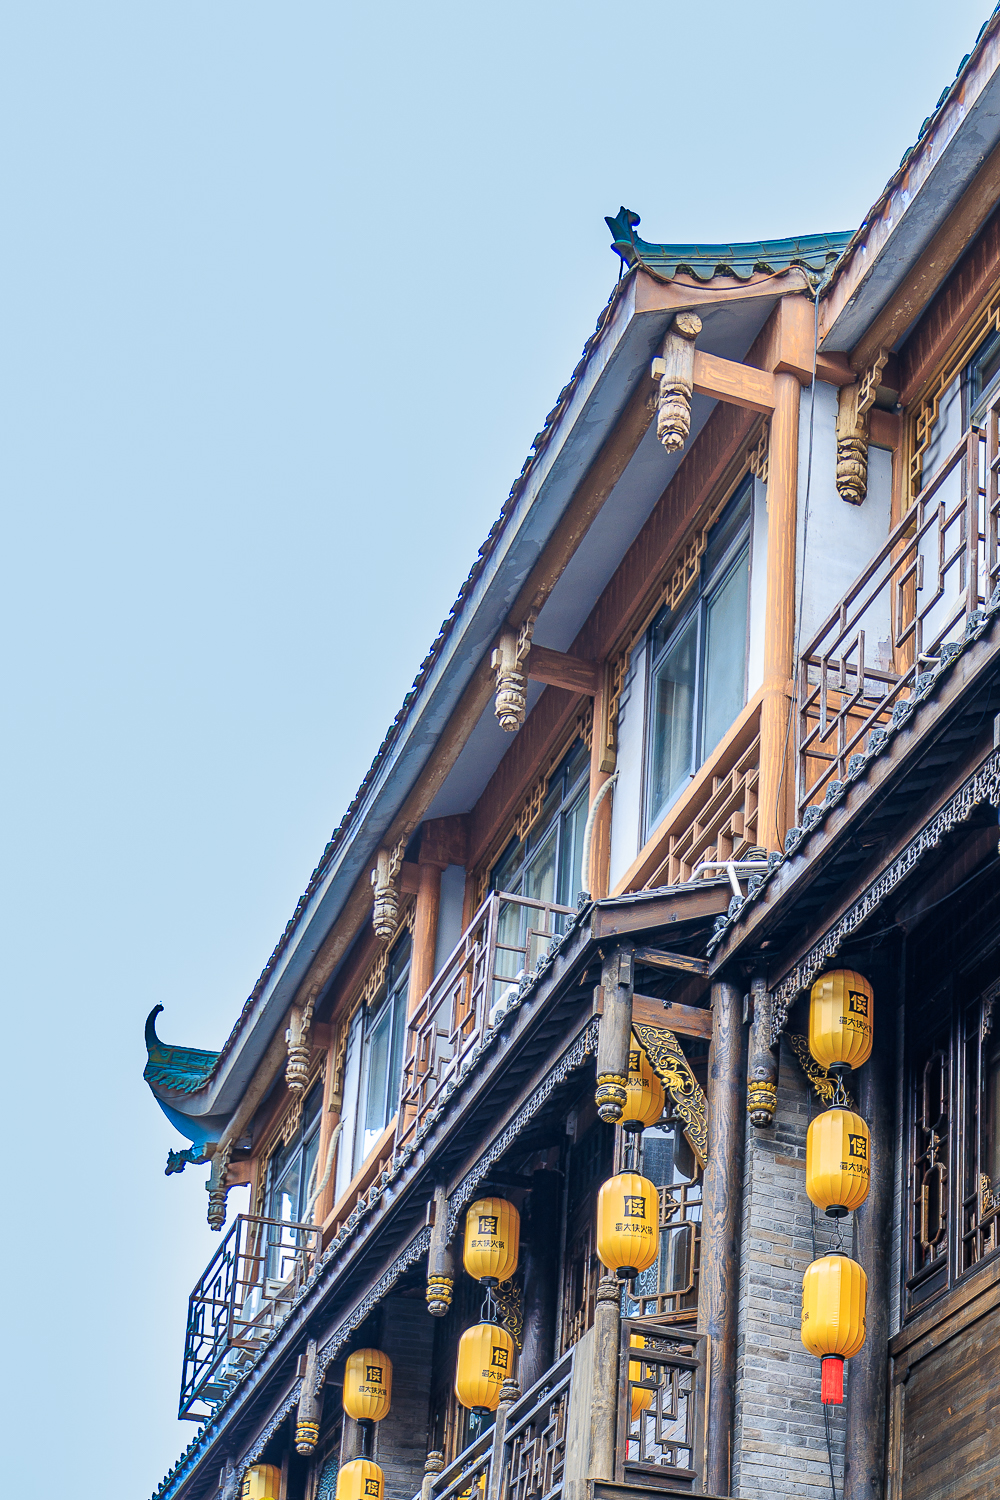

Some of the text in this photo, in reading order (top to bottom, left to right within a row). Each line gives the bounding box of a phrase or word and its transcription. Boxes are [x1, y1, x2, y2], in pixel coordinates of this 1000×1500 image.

[625, 1198, 644, 1217] 侠
[479, 1217, 496, 1233] 侠
[615, 1222, 653, 1236] 蜀大侠火锅
[471, 1240, 505, 1249] 蜀大侠火锅
[493, 1349, 507, 1367] 侠
